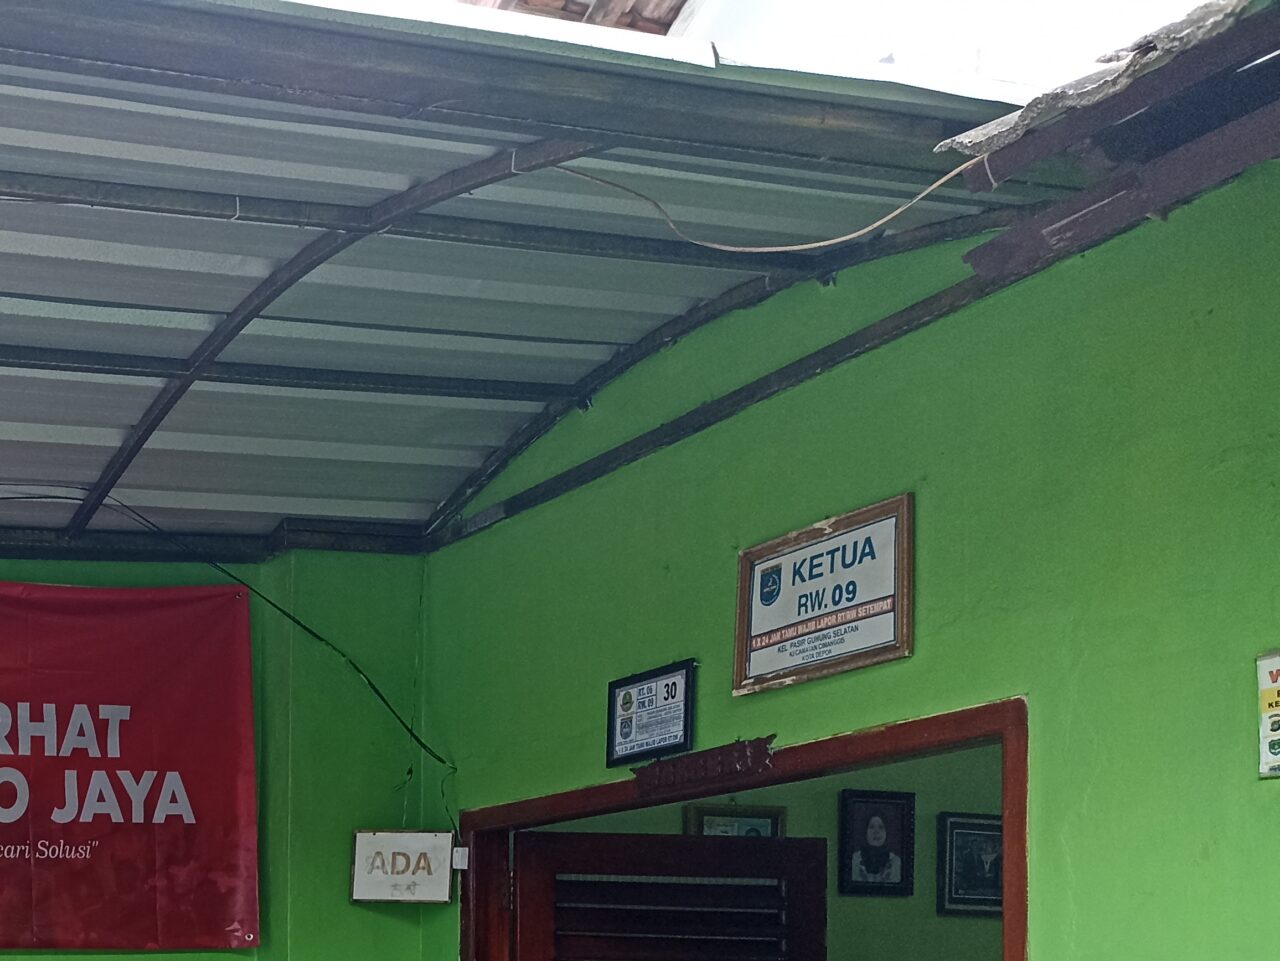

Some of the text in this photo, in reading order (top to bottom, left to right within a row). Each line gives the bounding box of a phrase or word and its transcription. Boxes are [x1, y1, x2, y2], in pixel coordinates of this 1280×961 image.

[792, 535, 876, 586] KETUA
[797, 580, 857, 616] RW. 09
[833, 624, 859, 637] SELATAN
[663, 681, 677, 701] 30
[52, 770, 195, 824] JAYA
[36, 839, 99, 859] Solusi"
[368, 851, 433, 876] ADA
